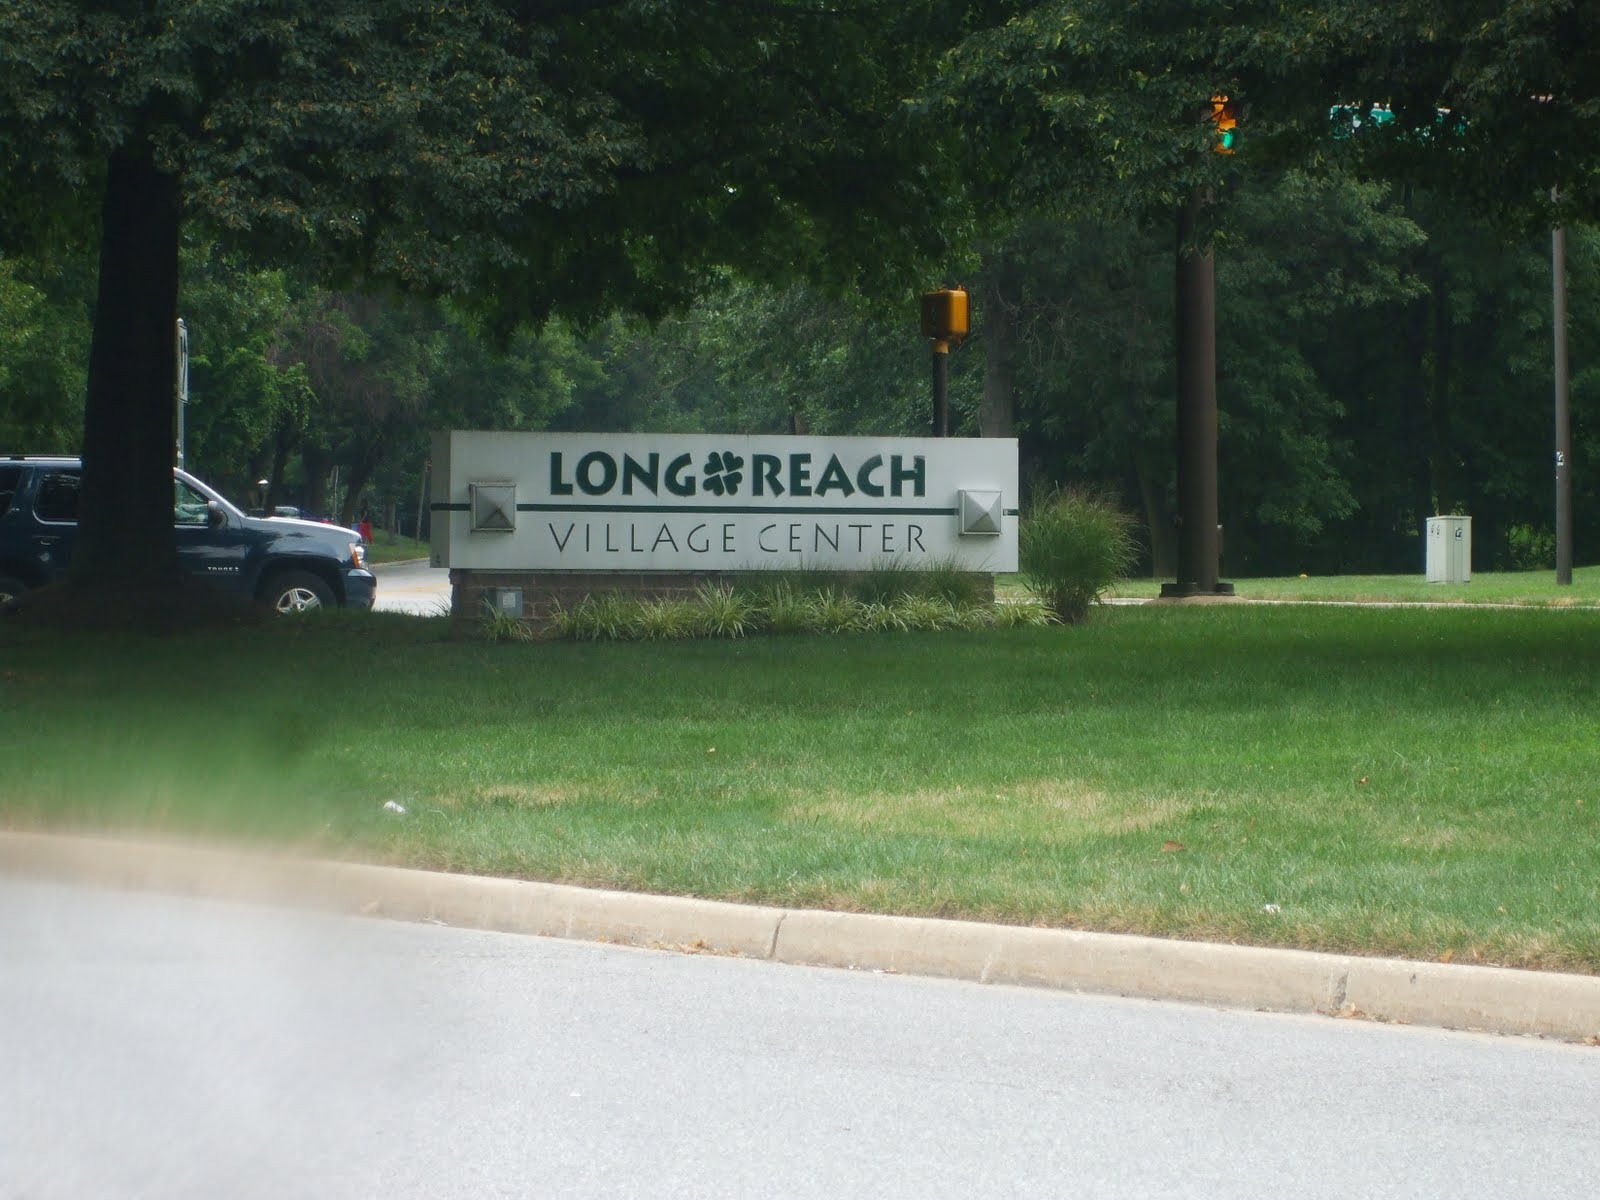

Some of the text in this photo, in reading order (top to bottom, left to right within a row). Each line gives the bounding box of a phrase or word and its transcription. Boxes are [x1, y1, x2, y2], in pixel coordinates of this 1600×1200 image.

[549, 450, 926, 498] LONG REACH
[547, 522, 926, 553] VILLAGE CENTER
